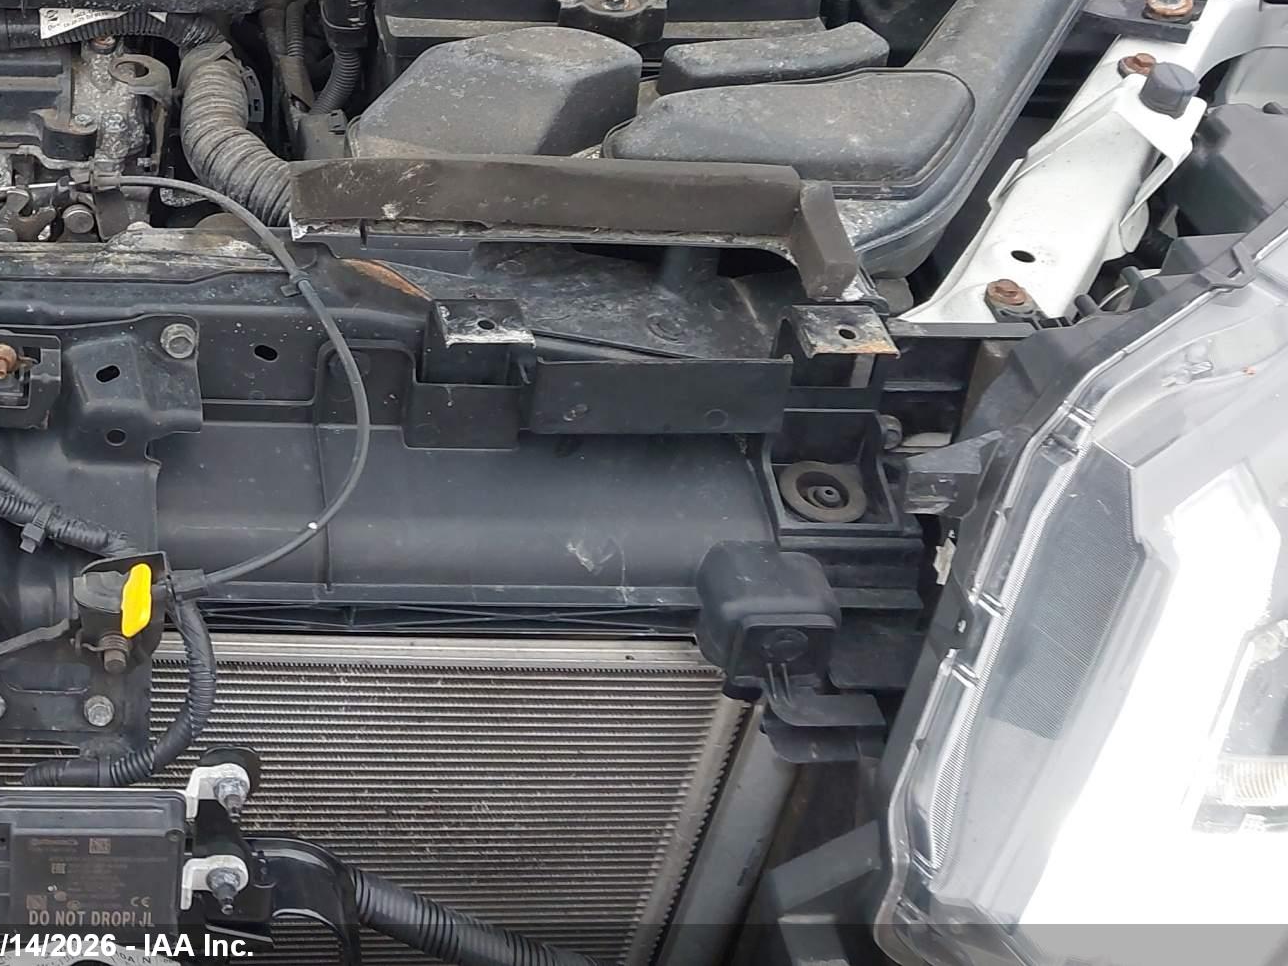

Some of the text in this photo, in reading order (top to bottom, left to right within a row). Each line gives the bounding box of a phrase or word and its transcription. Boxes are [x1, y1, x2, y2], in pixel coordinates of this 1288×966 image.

[29, 910, 50, 926] DO
[55, 910, 86, 927] NOT
[92, 910, 136, 927] DROP!
